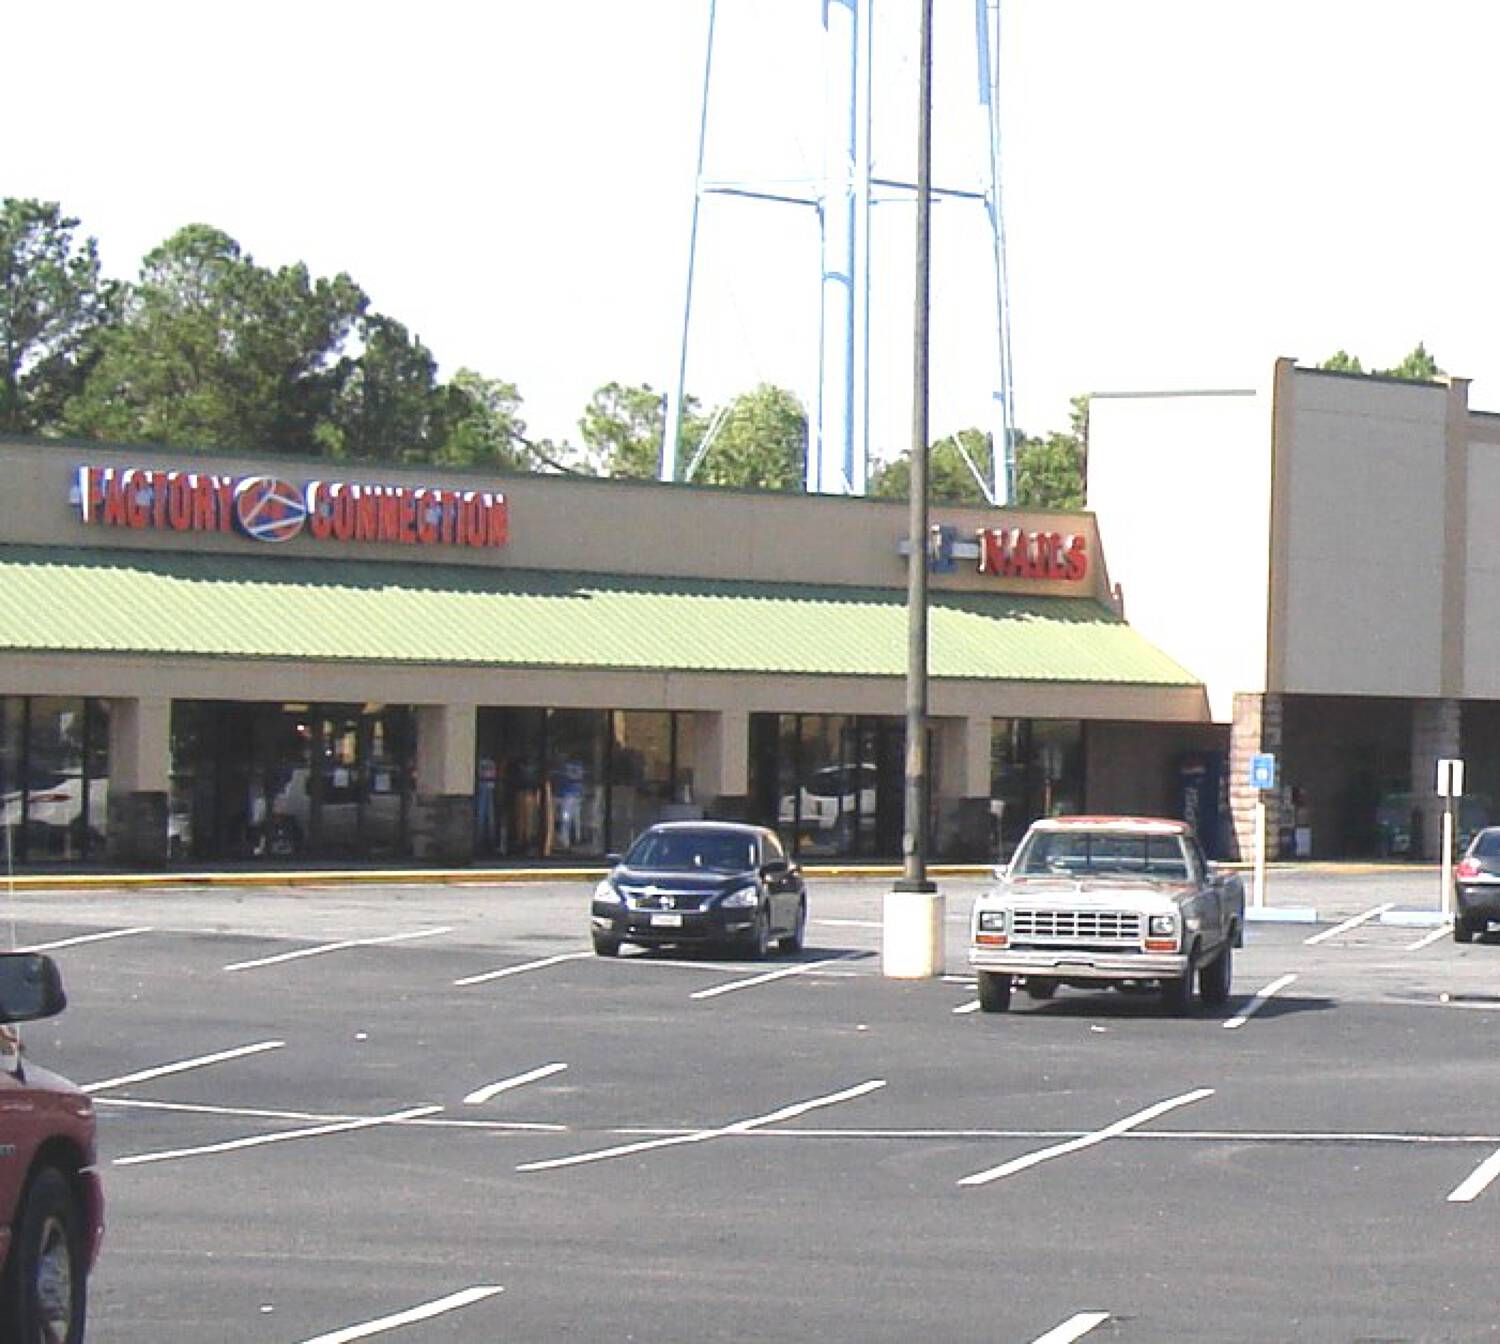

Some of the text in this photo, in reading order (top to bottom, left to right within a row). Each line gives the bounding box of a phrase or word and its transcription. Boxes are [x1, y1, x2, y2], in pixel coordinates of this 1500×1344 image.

[79, 466, 508, 547] FACTORY CONNECTION
[976, 528, 1087, 580] NAILS
